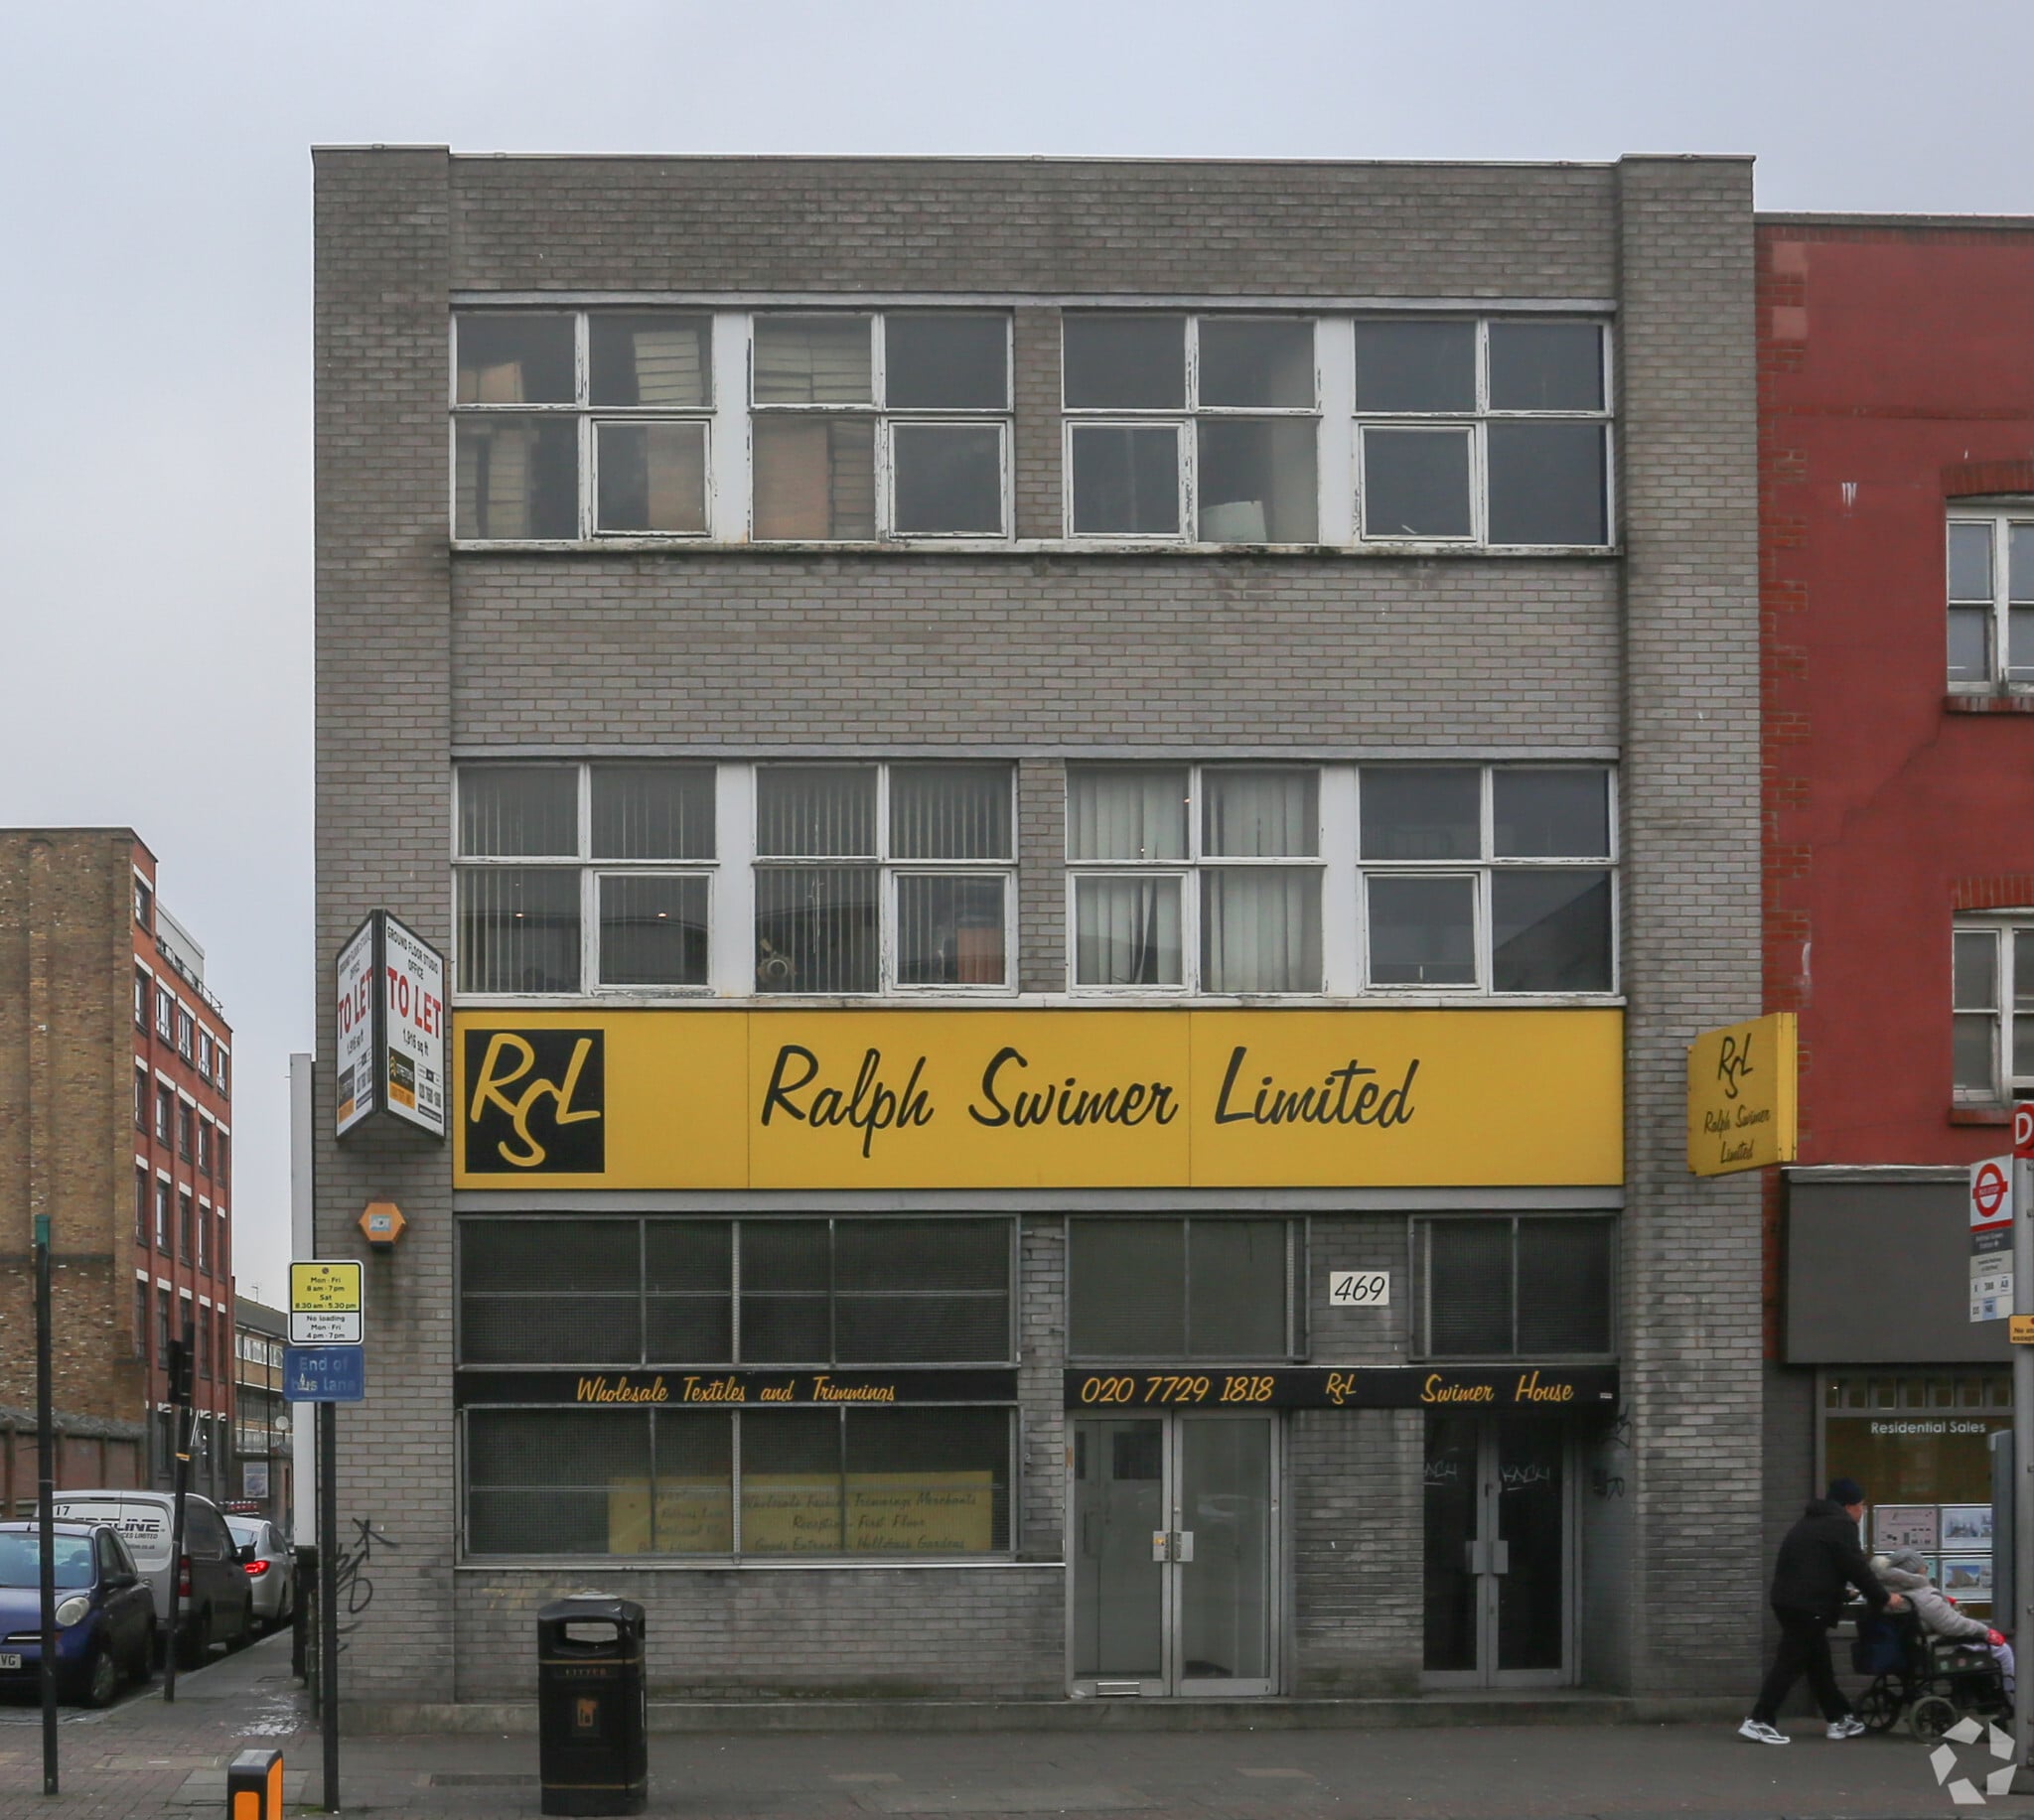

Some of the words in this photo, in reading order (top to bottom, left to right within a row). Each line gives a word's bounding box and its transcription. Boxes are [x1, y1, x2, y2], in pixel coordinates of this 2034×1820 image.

[339, 993, 352, 1040] TO
[355, 967, 373, 1025] LET
[387, 966, 410, 1018] TO
[415, 984, 441, 1040] LET
[761, 1045, 935, 1159] Ralph
[968, 1047, 1179, 1128] Swimer
[1215, 1046, 1420, 1129] Limited
[1704, 1109, 1731, 1139] Ralph
[1735, 1104, 1771, 1129] Swimer
[2015, 1112, 2033, 1145] D
[1720, 1139, 1756, 1164] Limited
[1335, 1276, 1385, 1302] 469
[299, 1355, 327, 1371] End
[577, 1375, 668, 1402] Wholesale
[682, 1375, 746, 1402] Textiles
[760, 1379, 794, 1401] and
[811, 1375, 895, 1402] Trimmings
[1082, 1377, 1135, 1403] 020
[1144, 1377, 1210, 1403] 7729
[1220, 1376, 1274, 1402] 1818
[1420, 1374, 1495, 1403] Swimer
[1515, 1370, 1574, 1403] House
[1870, 1421, 1947, 1434] Residential
[1950, 1421, 1986, 1434] Sales
